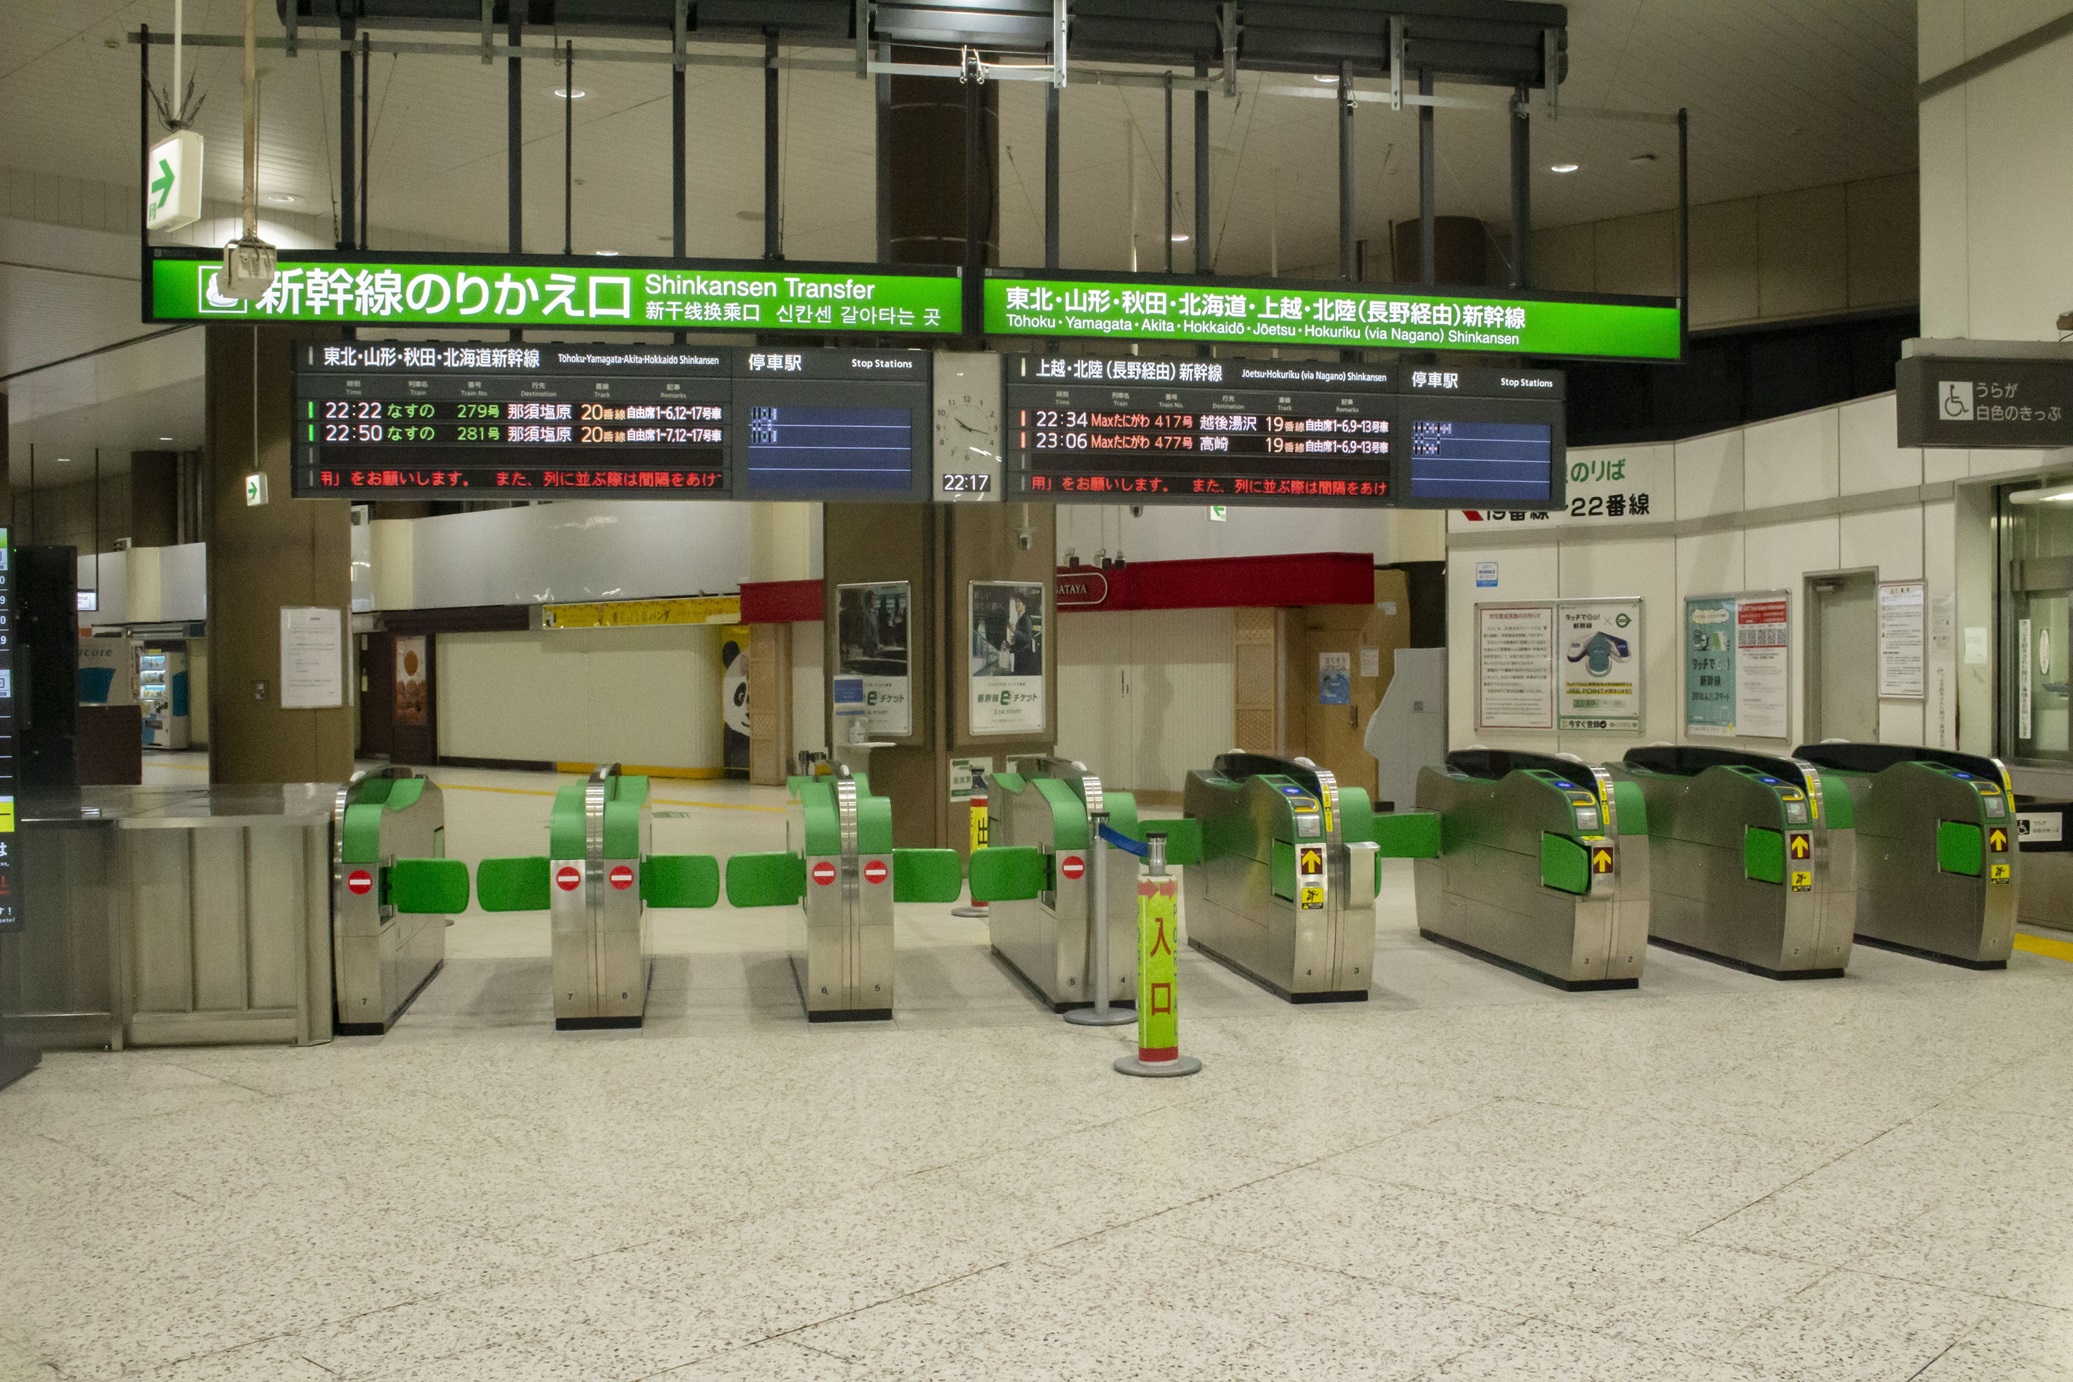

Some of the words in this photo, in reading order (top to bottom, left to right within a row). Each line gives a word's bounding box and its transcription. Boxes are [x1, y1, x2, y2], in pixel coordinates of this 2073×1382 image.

[255, 267, 632, 318] 新幹線のりかえ口
[645, 274, 777, 297] Shinkansen
[784, 278, 876, 300] Transfer
[645, 301, 761, 322] 新干线换乘口
[776, 305, 832, 324] 신칸센
[841, 306, 916, 326] 갈아타는
[923, 308, 941, 327] 곳
[1065, 316, 1132, 332] Yamagata
[1141, 319, 1174, 332] Akita
[1304, 325, 1361, 339] Hokuriku
[1364, 326, 1388, 341] (via
[1391, 328, 1444, 343] Nagano)
[1448, 331, 1519, 345] Shinkansen
[679, 355, 719, 365] Shinkansen
[748, 354, 802, 371] 停車駅
[851, 358, 873, 369] Stop
[875, 359, 913, 369] Stations
[1301, 370, 1314, 380] (via
[1316, 371, 1346, 382] Nagano)
[1347, 373, 1387, 382] Shinkansen
[1412, 371, 1459, 388] 停車駅
[1501, 377, 1519, 388] Stop
[1521, 378, 1553, 388] Stations
[1976, 382, 2018, 398] うらが
[325, 402, 382, 419] 22:22
[387, 404, 435, 419] なすの
[457, 404, 500, 419] 279号
[507, 403, 572, 420] 那須塩原
[1036, 411, 1088, 428] 22:34
[1091, 413, 1150, 428] Maxたにがわ
[1155, 415, 1193, 429] 417号
[1200, 414, 1257, 431] 越後湯沢
[325, 424, 383, 441] 22:50
[387, 426, 435, 441] なすの
[457, 427, 500, 441] 281号
[507, 426, 572, 442] 那須塩原
[1036, 433, 1088, 448] 23:06
[1091, 434, 1150, 449] Maxたにがわ
[1155, 436, 1193, 449] 477号
[1200, 436, 1229, 452] 高崎
[1565, 459, 1626, 483] のりば
[944, 474, 989, 491] 22:17
[1150, 917, 1171, 1016] 入口
